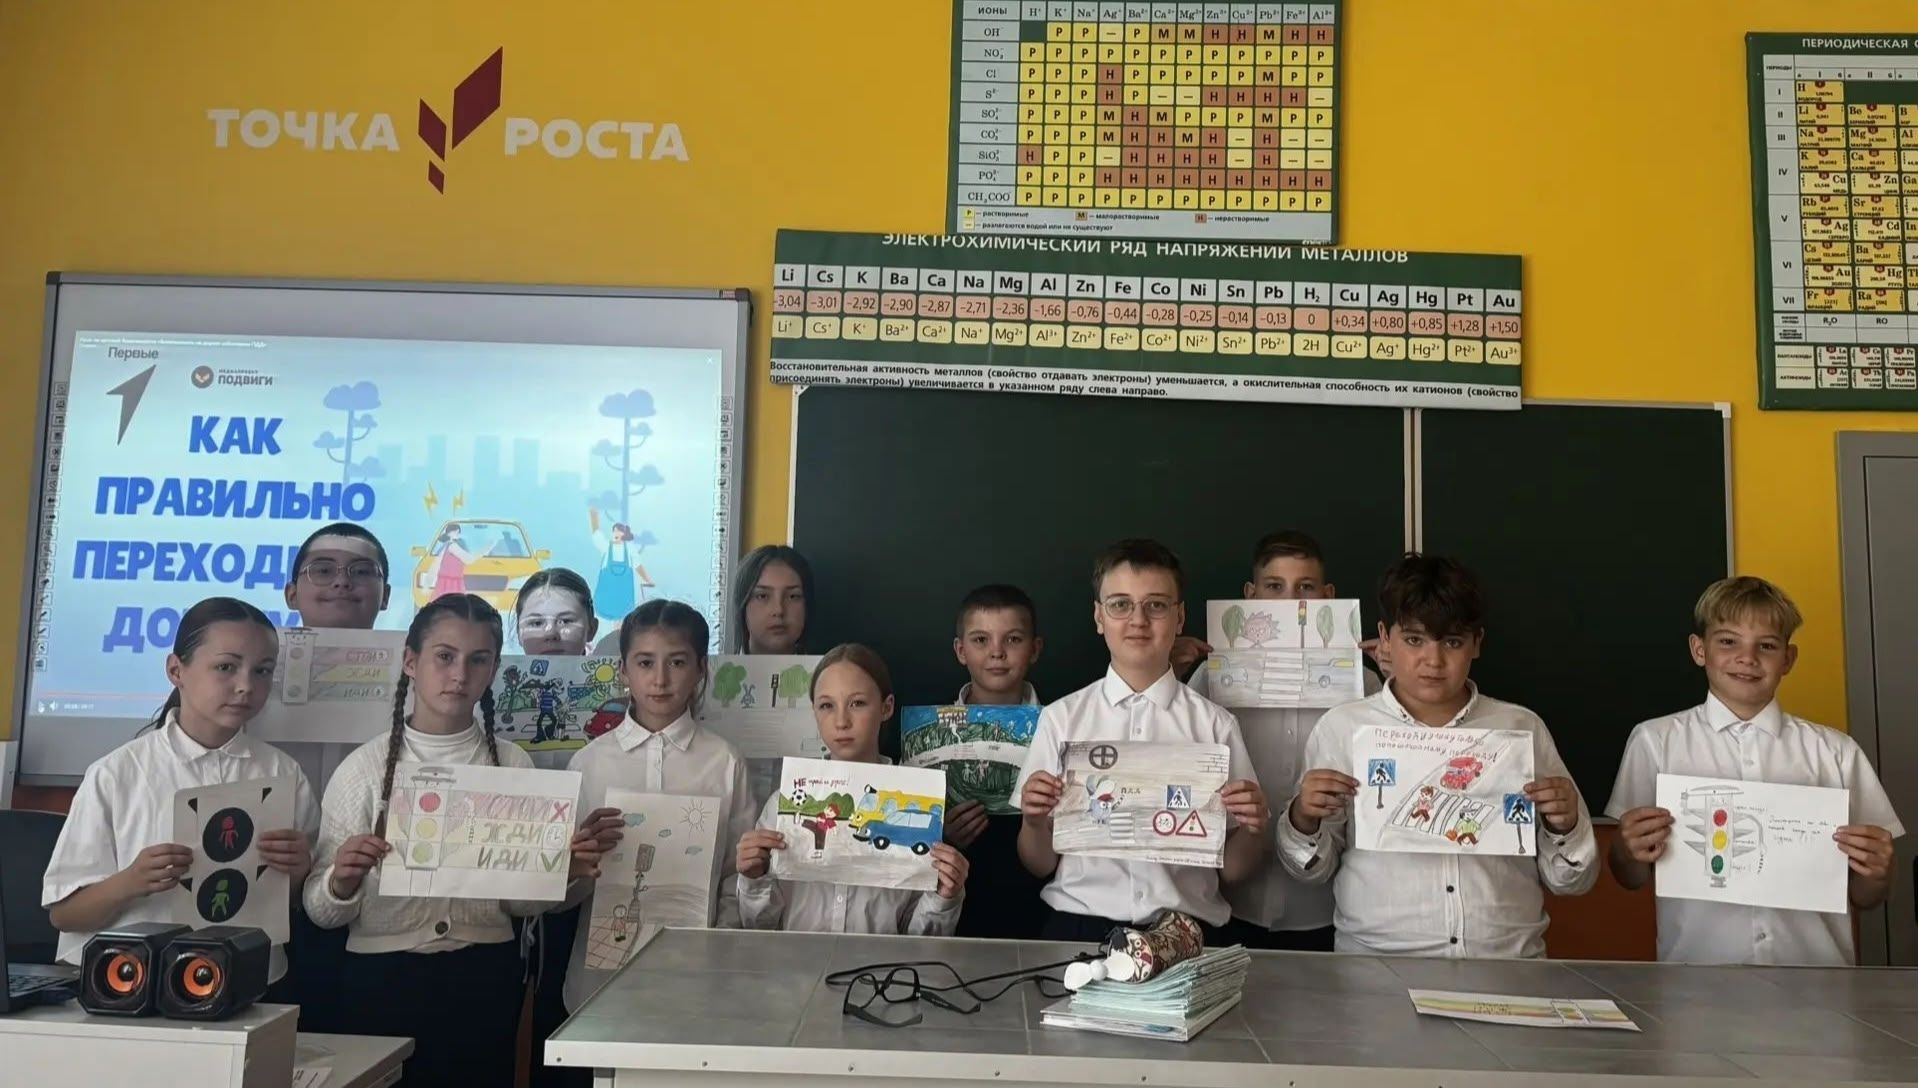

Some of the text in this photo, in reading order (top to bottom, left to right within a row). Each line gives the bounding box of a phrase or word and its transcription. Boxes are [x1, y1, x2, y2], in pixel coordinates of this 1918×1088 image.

[1802, 38, 1908, 49] ПЕРИОДИЧЕСКАЯ
[207, 108, 689, 161] ТОЧКА РОСТА
[1800, 129, 1813, 137] Na
[1851, 130, 1865, 139] Mg
[1851, 153, 1863, 161] Ca
[1833, 175, 1846, 183] Cu
[1884, 176, 1897, 184] Zn
[1802, 198, 1816, 206] Rb
[1835, 223, 1848, 231] Ag
[1887, 222, 1900, 230] Cd
[1110, 240, 1147, 257] РЯД
[1302, 247, 1408, 262] МЕТАЛЛОВ
[1856, 246, 1868, 254] Ba
[1888, 270, 1902, 279] Hg
[782, 268, 794, 282] Li
[817, 270, 834, 283] Cs
[857, 271, 868, 283] K
[890, 273, 909, 285] Ba
[927, 274, 946, 287] Ca
[963, 276, 985, 288] Na
[1000, 277, 1023, 292] Mg
[1041, 277, 1056, 290] Al
[1077, 280, 1095, 292] Zn
[1115, 282, 1131, 293] Fe
[1151, 283, 1171, 294] Co
[1190, 283, 1207, 296] Ni
[1227, 285, 1245, 298] Sn
[1264, 286, 1283, 298] Pb
[1340, 290, 1360, 302] Cu
[1377, 291, 1399, 305] Ag
[1416, 292, 1437, 307] Hg
[1457, 293, 1473, 306] Pt
[1493, 295, 1515, 308] Au
[1858, 292, 1872, 300] Ra
[1308, 312, 1315, 325] 0
[1334, 314, 1365, 327] +0,34
[1372, 315, 1404, 328] +0,80
[1411, 317, 1442, 329] +0,85
[1450, 318, 1479, 331] +1,28
[1490, 320, 1518, 333] +1,50
[1302, 339, 1320, 350] 2H
[108, 347, 159, 361] Первые
[218, 374, 273, 387] ПОДВИГИ
[770, 362, 868, 372] Восстановительная
[872, 366, 930, 375] активность
[934, 368, 982, 377] металлов
[988, 368, 1036, 379] (свойство
[1042, 372, 1088, 381] отдавать
[1092, 373, 1151, 384] электроны)
[1156, 376, 1227, 387] уменьшается,
[1243, 380, 1321, 390] окислительная
[1326, 382, 1390, 392] способность
[1412, 387, 1462, 395] катионов
[1468, 386, 1518, 398] (свойство
[845, 376, 904, 387] электроны)
[908, 380, 984, 389] увеличивается
[1000, 383, 1055, 392] указанном
[1060, 386, 1084, 394] ряду
[1088, 386, 1117, 394] слева
[1122, 388, 1168, 397] направо.
[188, 415, 283, 456] КАК
[94, 476, 376, 521] ПРАВИЛЬНО
[794, 778, 806, 788] НЕ
[482, 822, 541, 845] ЖДИ
[477, 847, 529, 870] ИДИ
